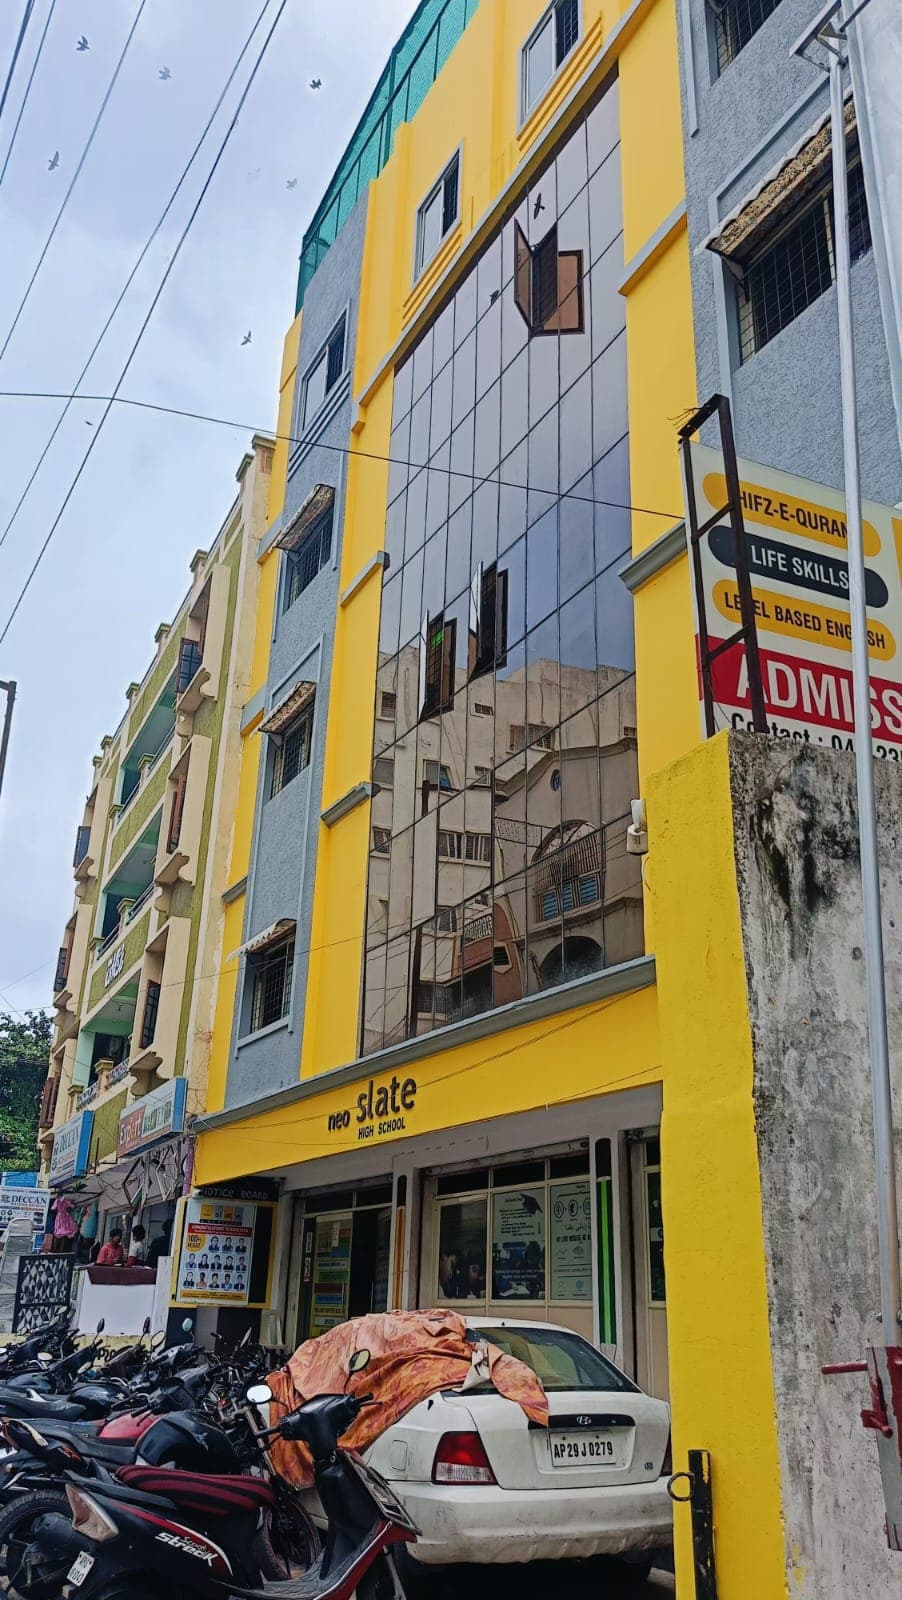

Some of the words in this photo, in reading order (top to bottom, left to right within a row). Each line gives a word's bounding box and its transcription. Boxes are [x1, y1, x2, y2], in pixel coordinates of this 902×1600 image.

[751, 545, 788, 572] LIFE
[792, 557, 849, 590] SKILLS
[724, 592, 771, 619] LEEL
[774, 605, 821, 631] BASED
[826, 619, 886, 649] ENGSH
[328, 1109, 351, 1132] neo
[357, 1076, 417, 1123] slate
[358, 1125, 374, 1139] HIGH
[378, 1117, 406, 1135] SCHOOL
[241, 1190, 269, 1200] BOARD
[155, 1532, 219, 1567] Streak
